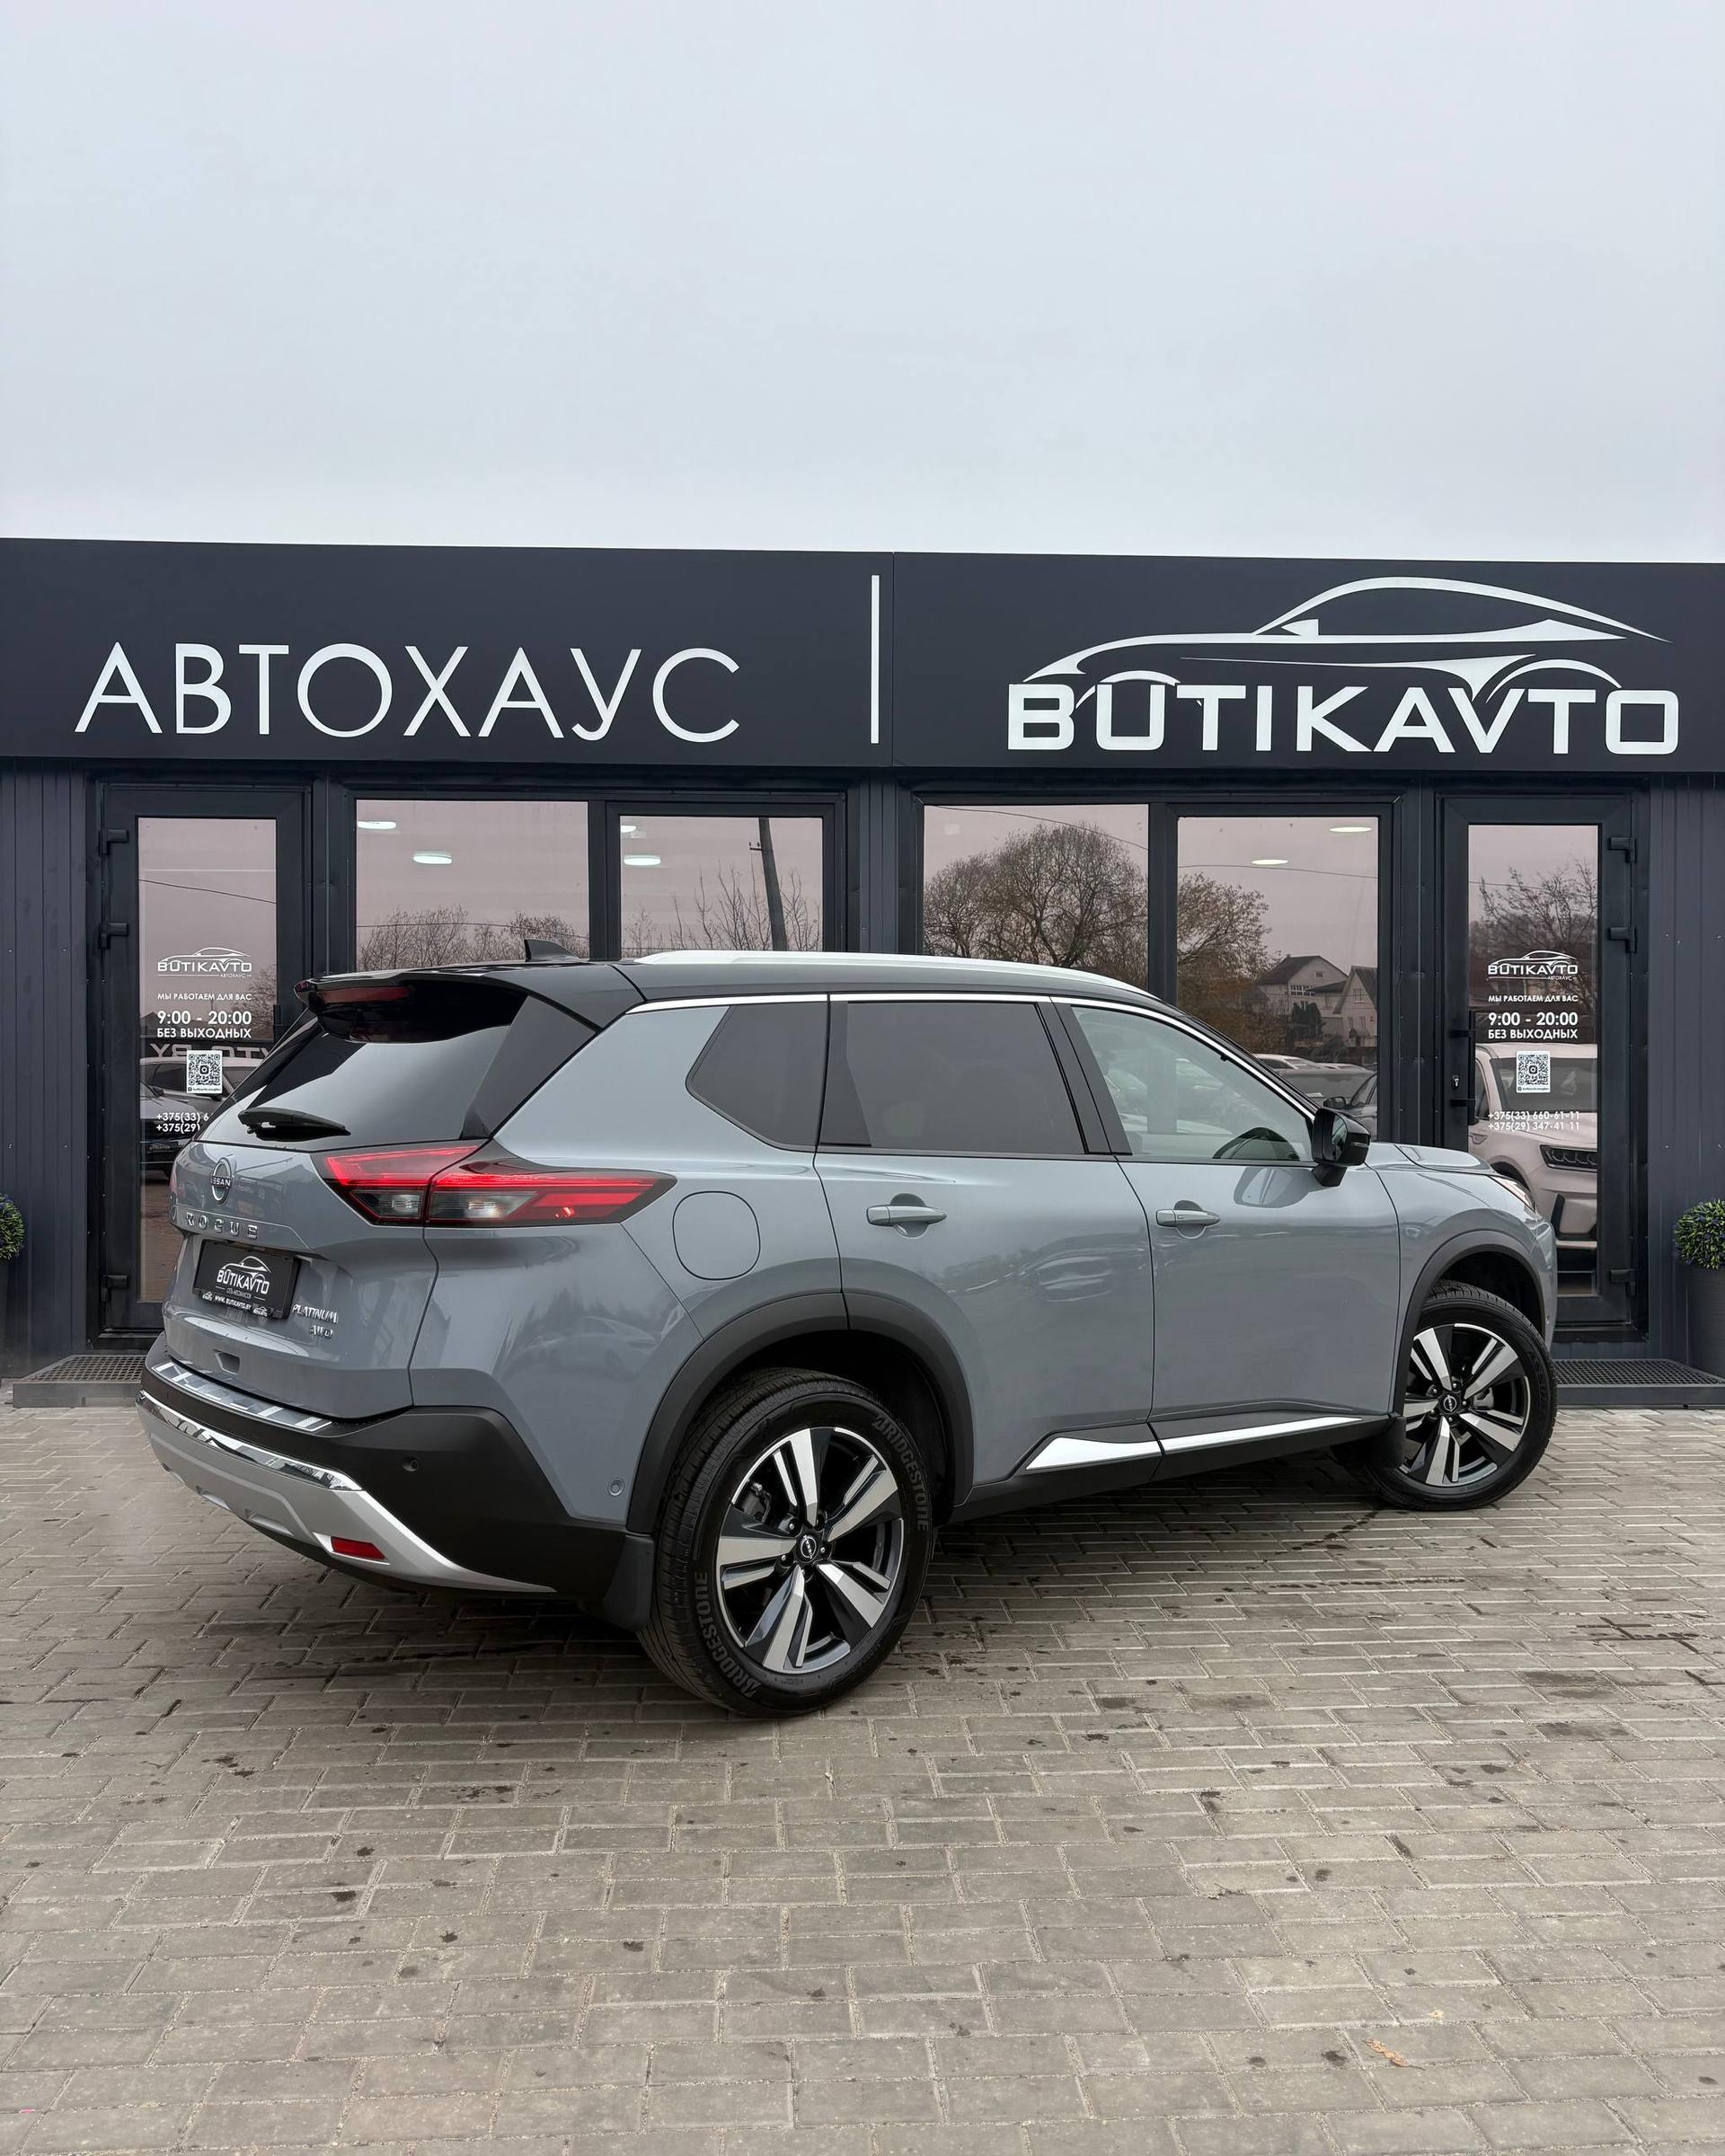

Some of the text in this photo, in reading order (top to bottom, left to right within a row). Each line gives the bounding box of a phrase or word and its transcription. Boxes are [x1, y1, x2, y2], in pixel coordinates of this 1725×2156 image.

[75, 641, 739, 743] АВТОХАУС
[1007, 682, 1680, 755] BUTIKAVTO
[157, 961, 252, 972] BUTIKAVTO
[1488, 964, 1579, 975] BUTIKAVTO
[1544, 995, 1561, 1003] ДЛЯ
[157, 1011, 191, 1025] 9:00
[208, 1011, 252, 1025] 20:00
[1488, 1012, 1521, 1026] 9:00
[1536, 1012, 1579, 1026] 20:00
[156, 1028, 252, 1039] БЕЗ ВЫХОДНЫХ
[1488, 1029, 1579, 1040] БЕЗ ВЫХОДНЫХ
[156, 1112, 200, 1124] +375(33)
[1488, 1110, 1579, 1122] +375(33) 660-61-11
[156, 1123, 200, 1134] +375(29)
[1488, 1121, 1530, 1132] +375(29)
[186, 1212, 258, 1240] ROGUE
[217, 1268, 270, 1294] BUTIKAVTO
[292, 1303, 337, 1323] PLATINUM
[871, 1415, 929, 1532] BRIDGESTONE
[694, 1572, 763, 1698] BRIDGESTONE
